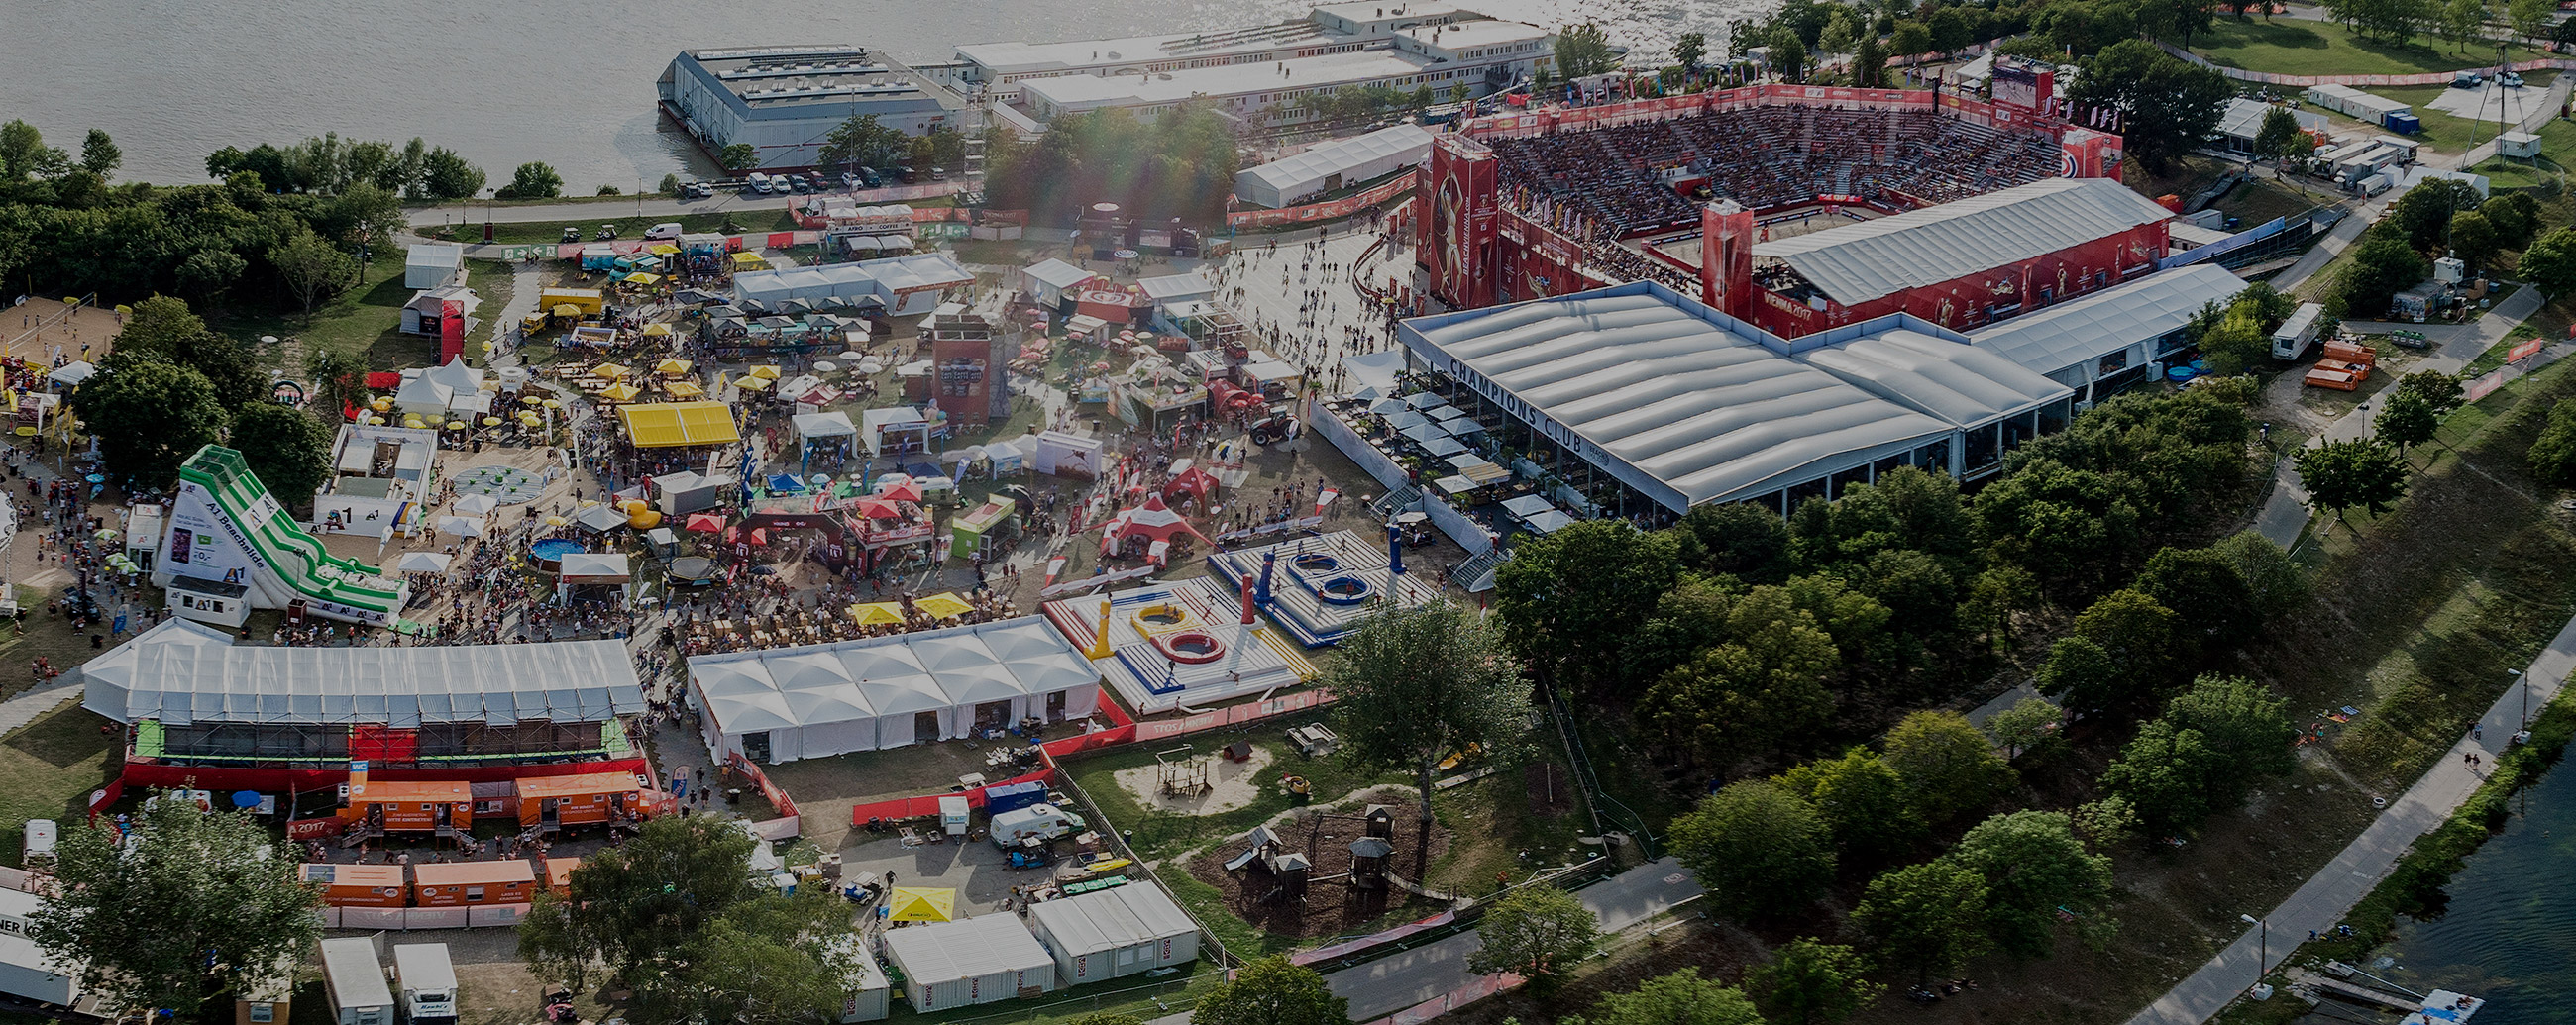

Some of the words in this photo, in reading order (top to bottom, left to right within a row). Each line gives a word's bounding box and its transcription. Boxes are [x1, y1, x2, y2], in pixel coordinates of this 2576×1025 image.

[1764, 291, 1793, 314] VIENNA
[1793, 304, 1812, 321] 2017
[1450, 358, 1536, 425] CHAMPIONS
[1545, 417, 1581, 453] CLUB
[324, 507, 351, 530] A1
[365, 510, 379, 520] A1
[207, 502, 221, 516] A1
[219, 515, 264, 569] Beachslide
[310, 524, 321, 533] A1
[223, 567, 245, 583] A1
[195, 600, 211, 611] A1
[298, 821, 325, 832] 2017
